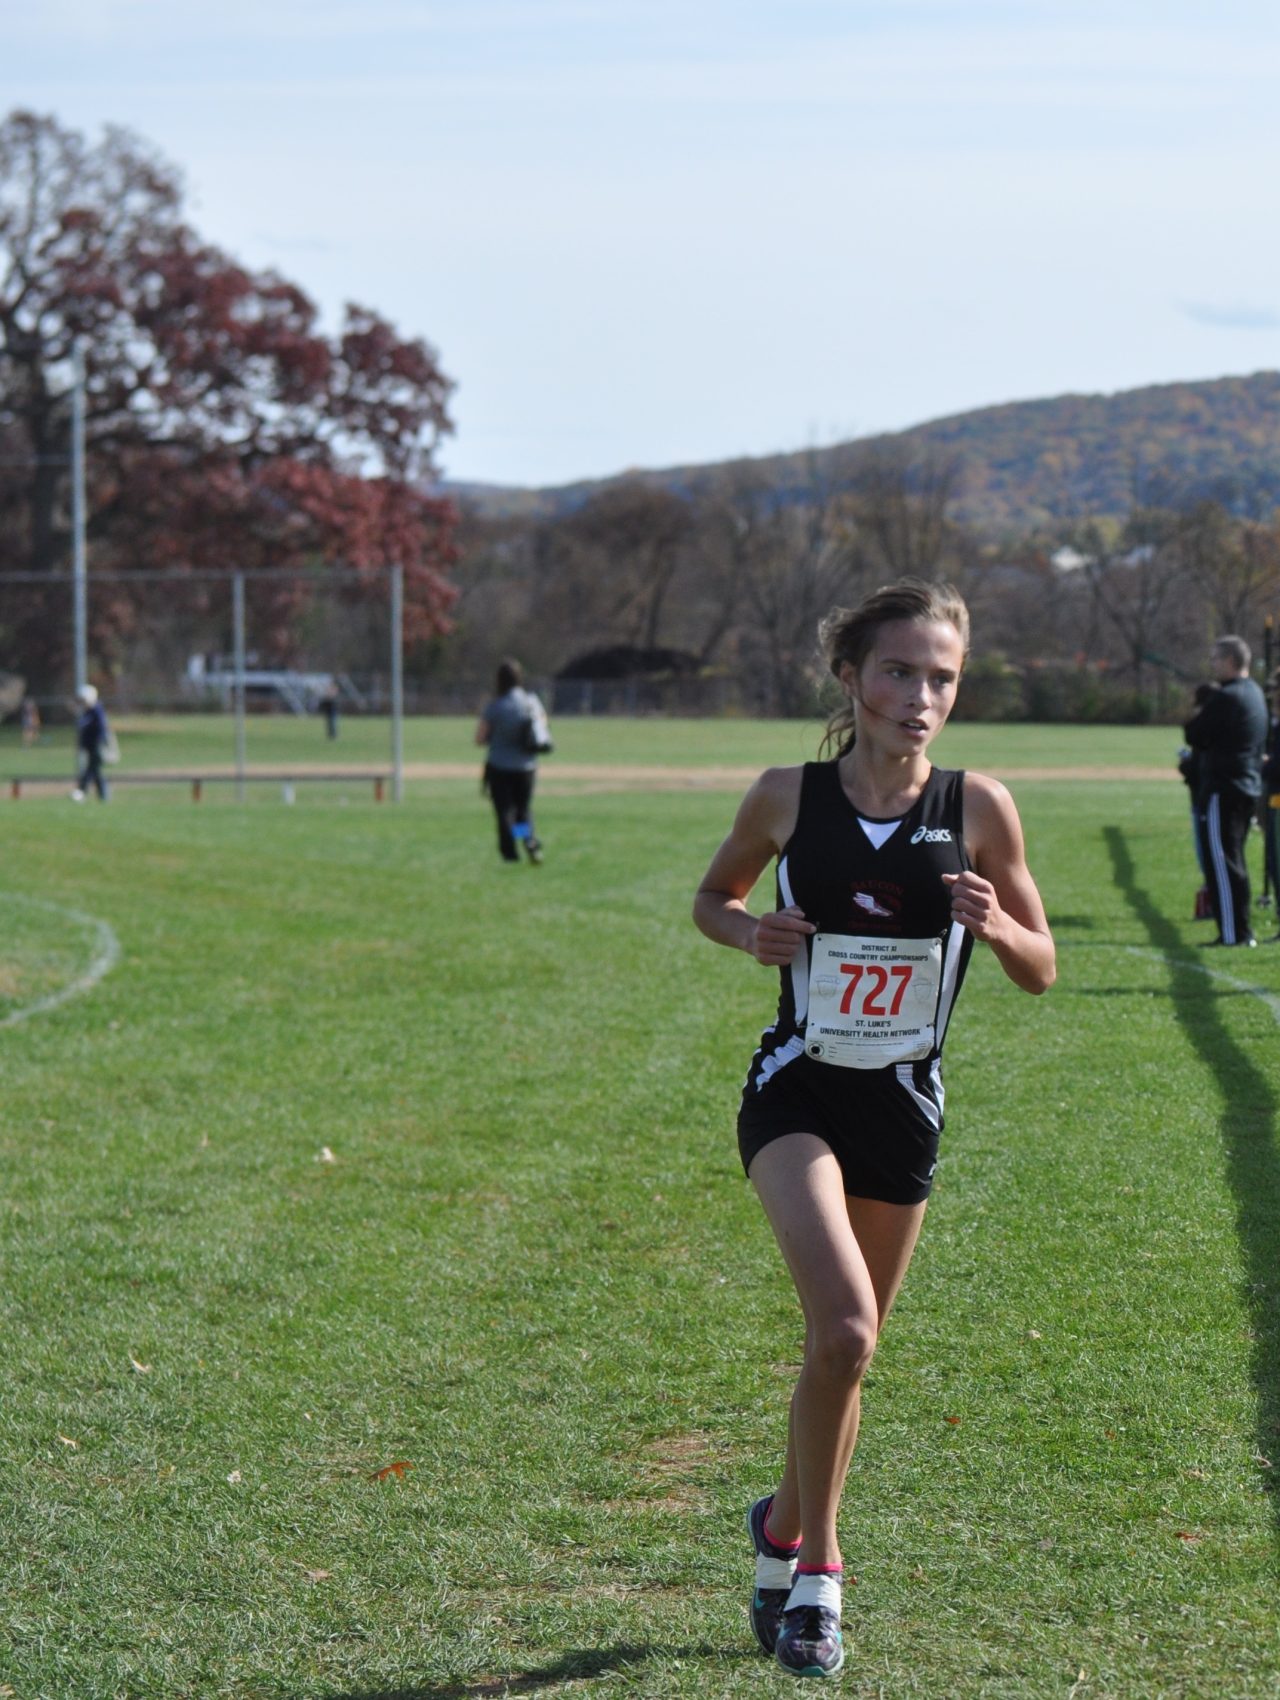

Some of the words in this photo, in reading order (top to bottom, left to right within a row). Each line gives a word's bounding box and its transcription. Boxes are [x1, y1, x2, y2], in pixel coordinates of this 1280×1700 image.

[861, 944, 889, 952] DISTRICT
[828, 950, 848, 959] CROSS
[849, 952, 879, 961] COUNTRY
[839, 963, 913, 1016] 727
[820, 1027, 861, 1037] UNIVERSITY
[863, 1029, 888, 1038] HEALTH
[890, 1028, 921, 1037] NETWORK
